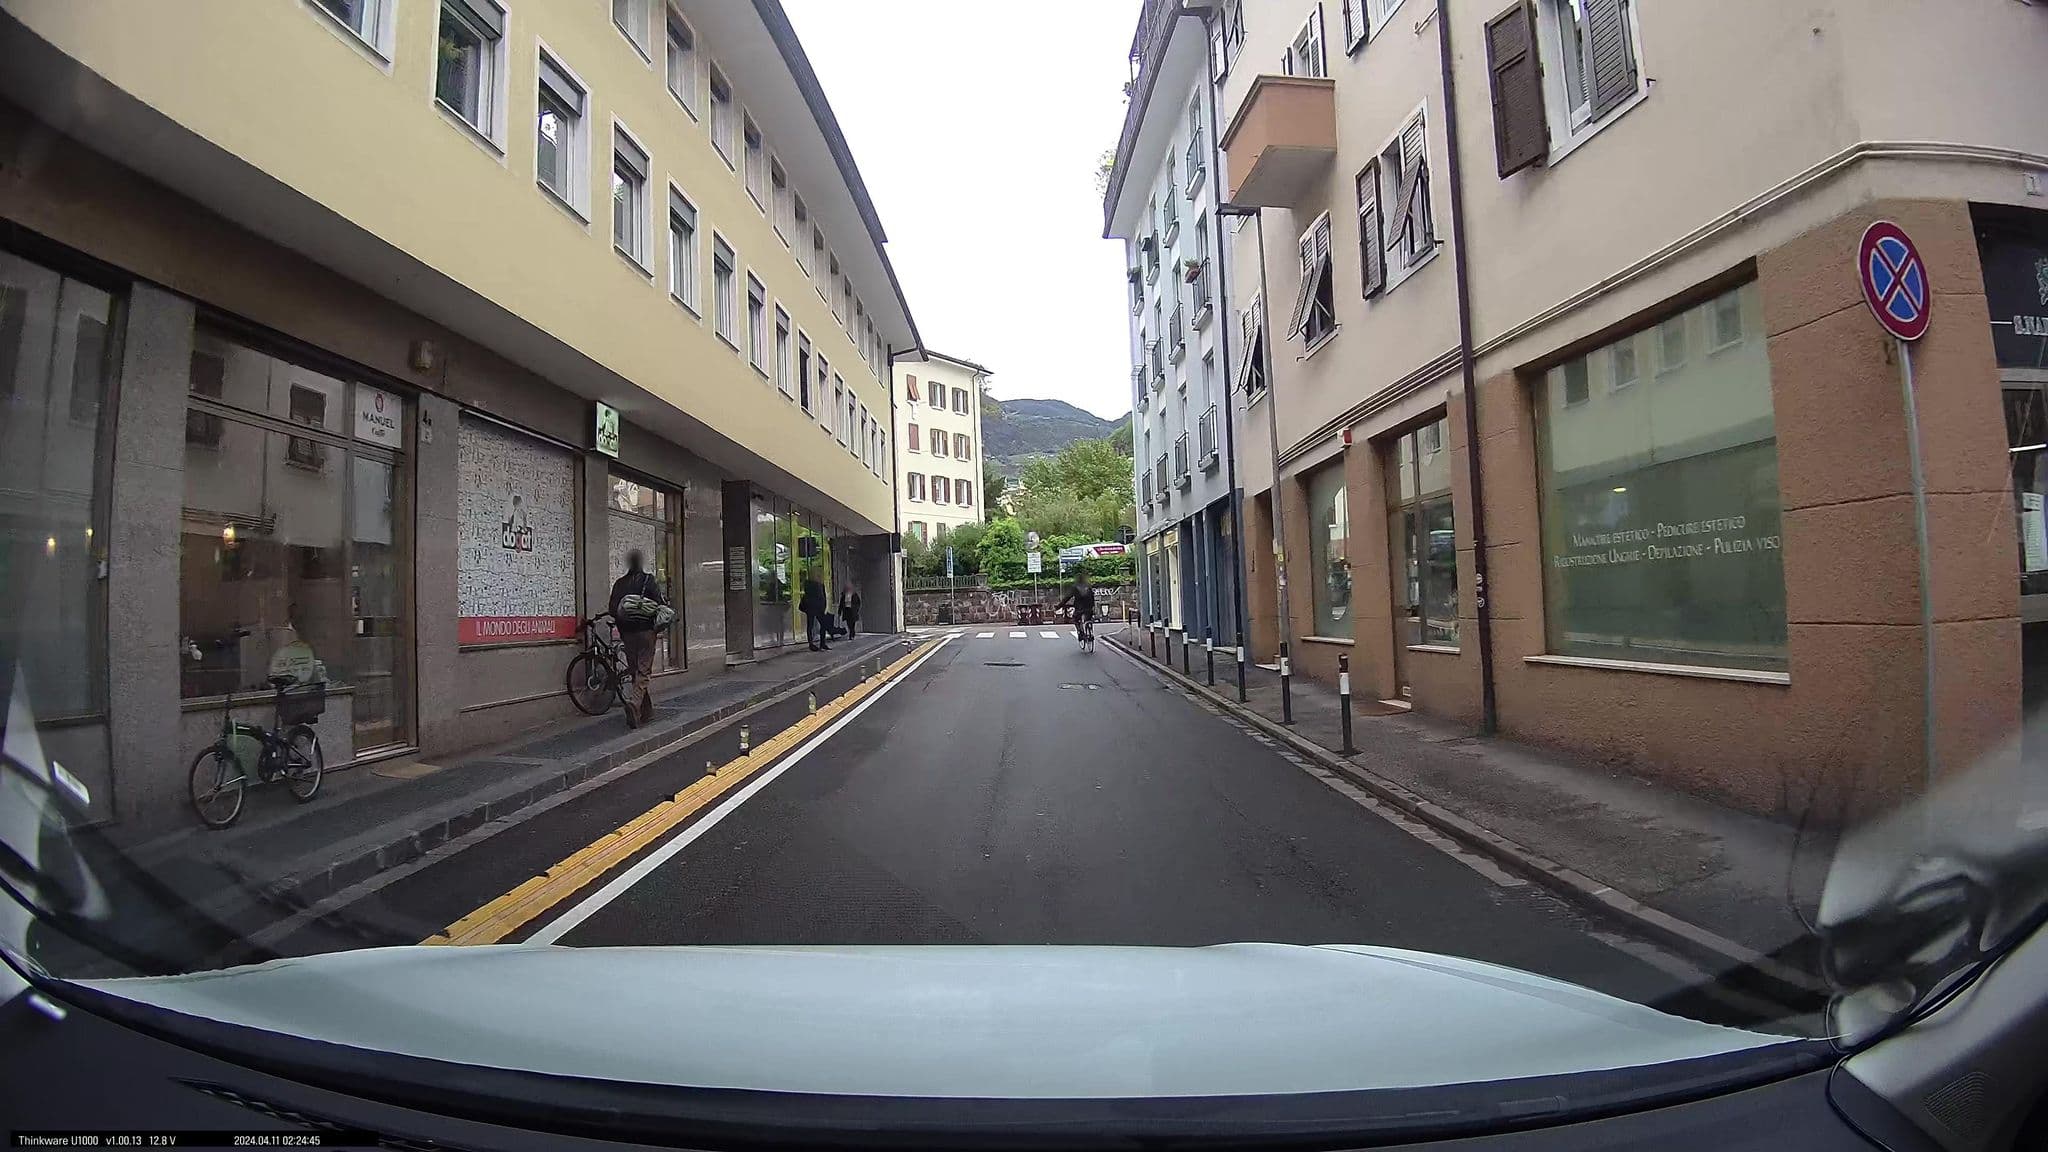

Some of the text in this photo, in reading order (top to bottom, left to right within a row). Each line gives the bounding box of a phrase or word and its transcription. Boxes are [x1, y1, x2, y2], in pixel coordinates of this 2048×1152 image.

[362, 411, 395, 430] MANUEL
[483, 620, 511, 636] MONDO
[512, 620, 531, 635] DEGLI
[531, 619, 556, 634] ANIMALI
